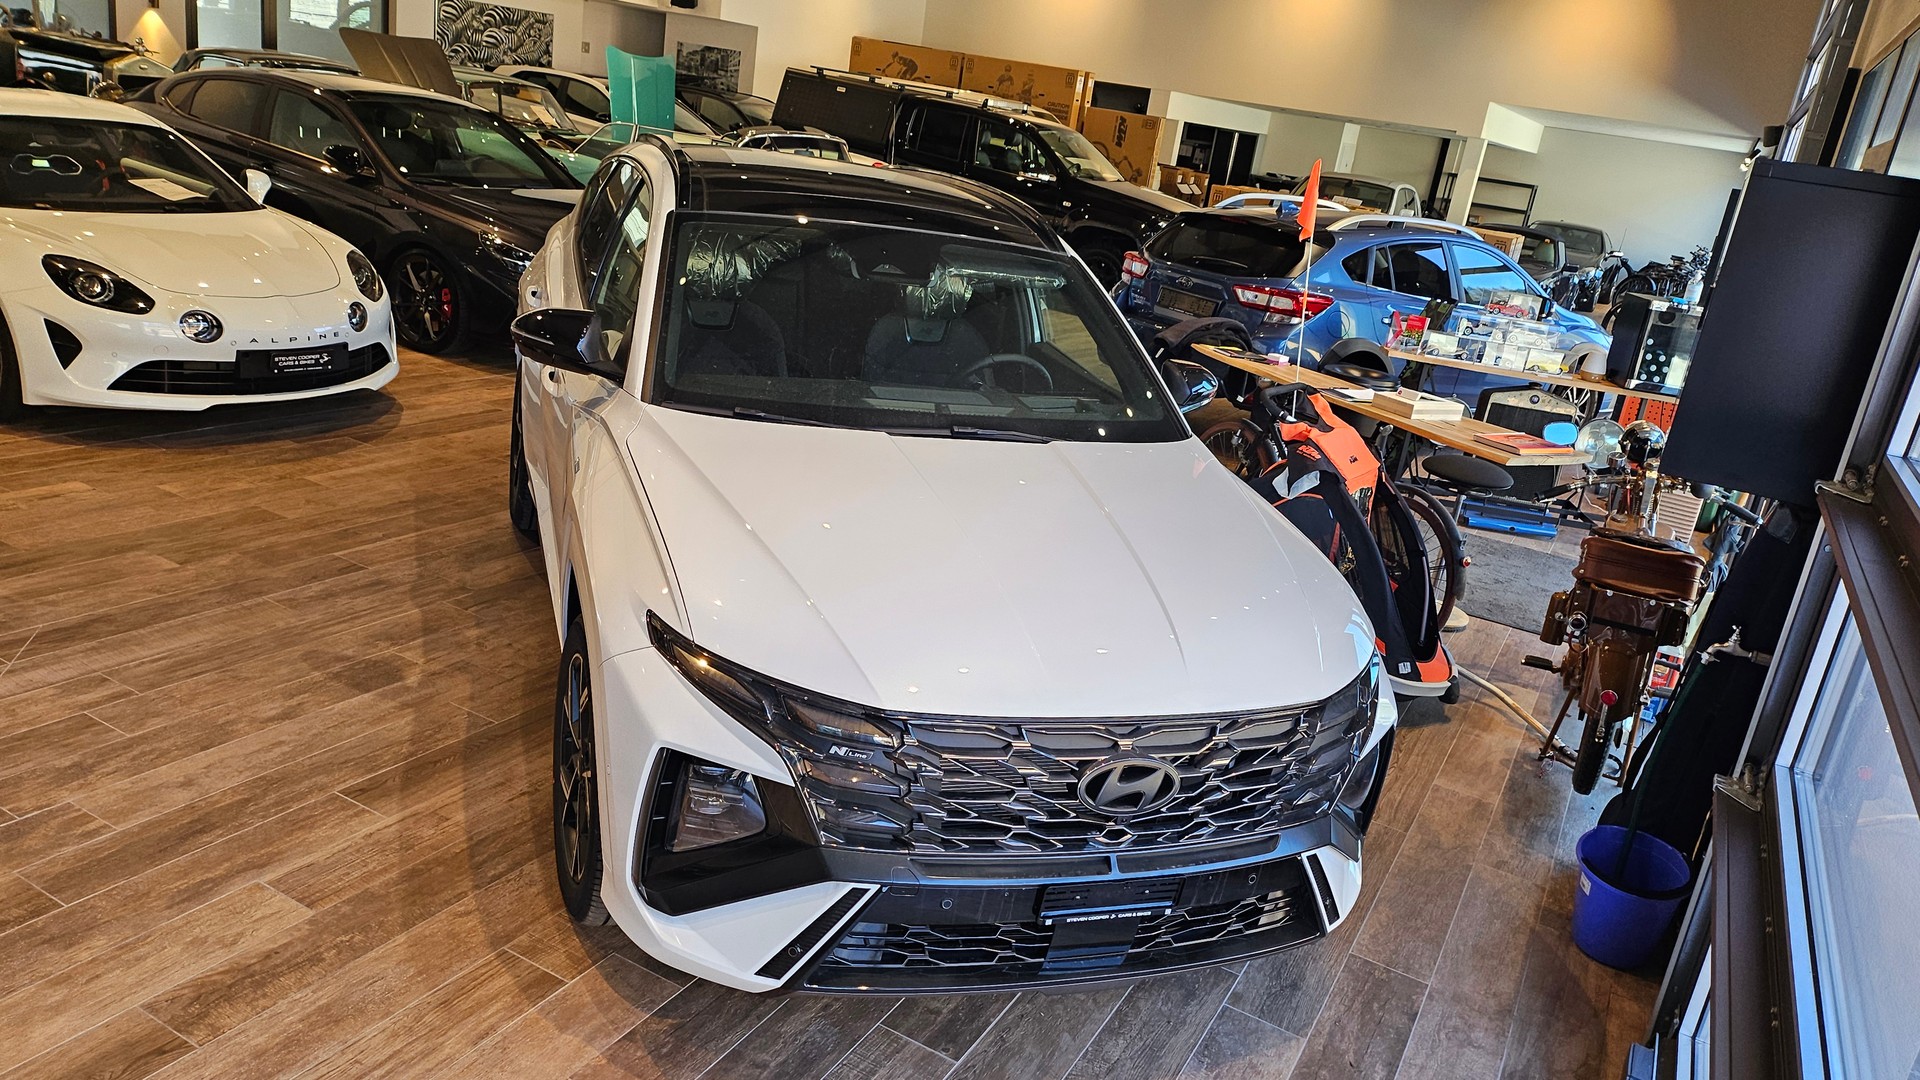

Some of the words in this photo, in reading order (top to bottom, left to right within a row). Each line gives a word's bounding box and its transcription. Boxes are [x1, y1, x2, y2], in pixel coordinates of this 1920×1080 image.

[1115, 115, 1128, 148] KTM
[249, 331, 340, 344] ALPINE
[1298, 444, 1321, 459] KTM
[829, 745, 848, 757] N
[848, 751, 867, 759] Line
